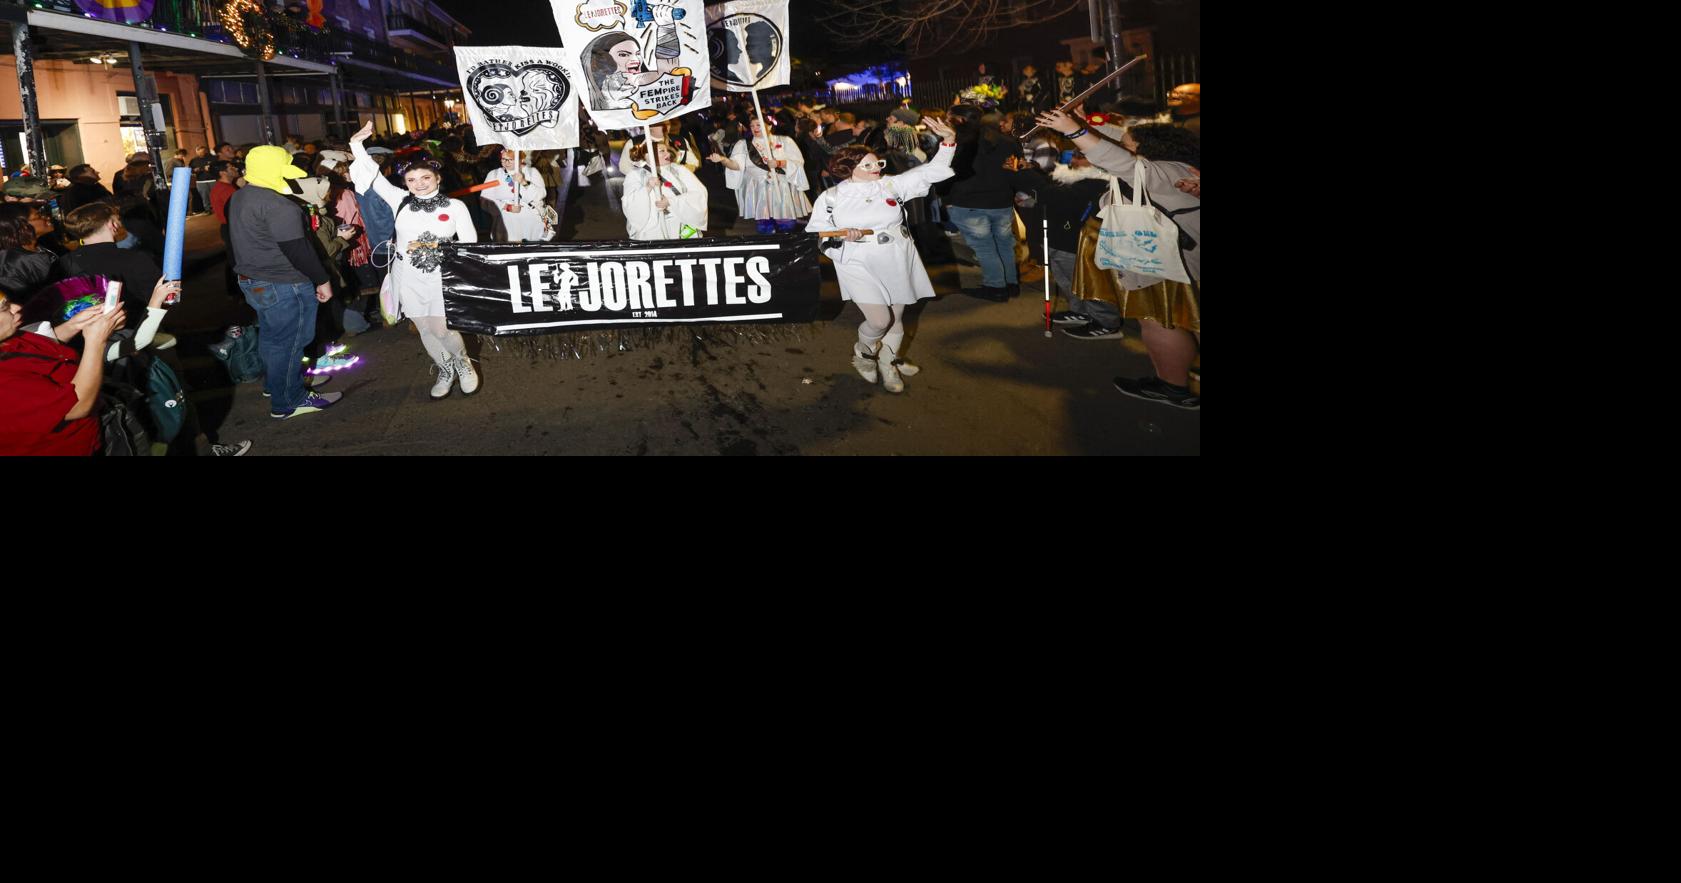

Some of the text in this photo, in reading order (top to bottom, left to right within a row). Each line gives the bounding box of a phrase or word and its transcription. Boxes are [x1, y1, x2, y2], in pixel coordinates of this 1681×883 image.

[477, 59, 513, 67] RATHER
[514, 59, 534, 69] KISS
[640, 85, 680, 98] FEMPIRE
[644, 93, 680, 105] STRIKES
[656, 100, 677, 109] BACK
